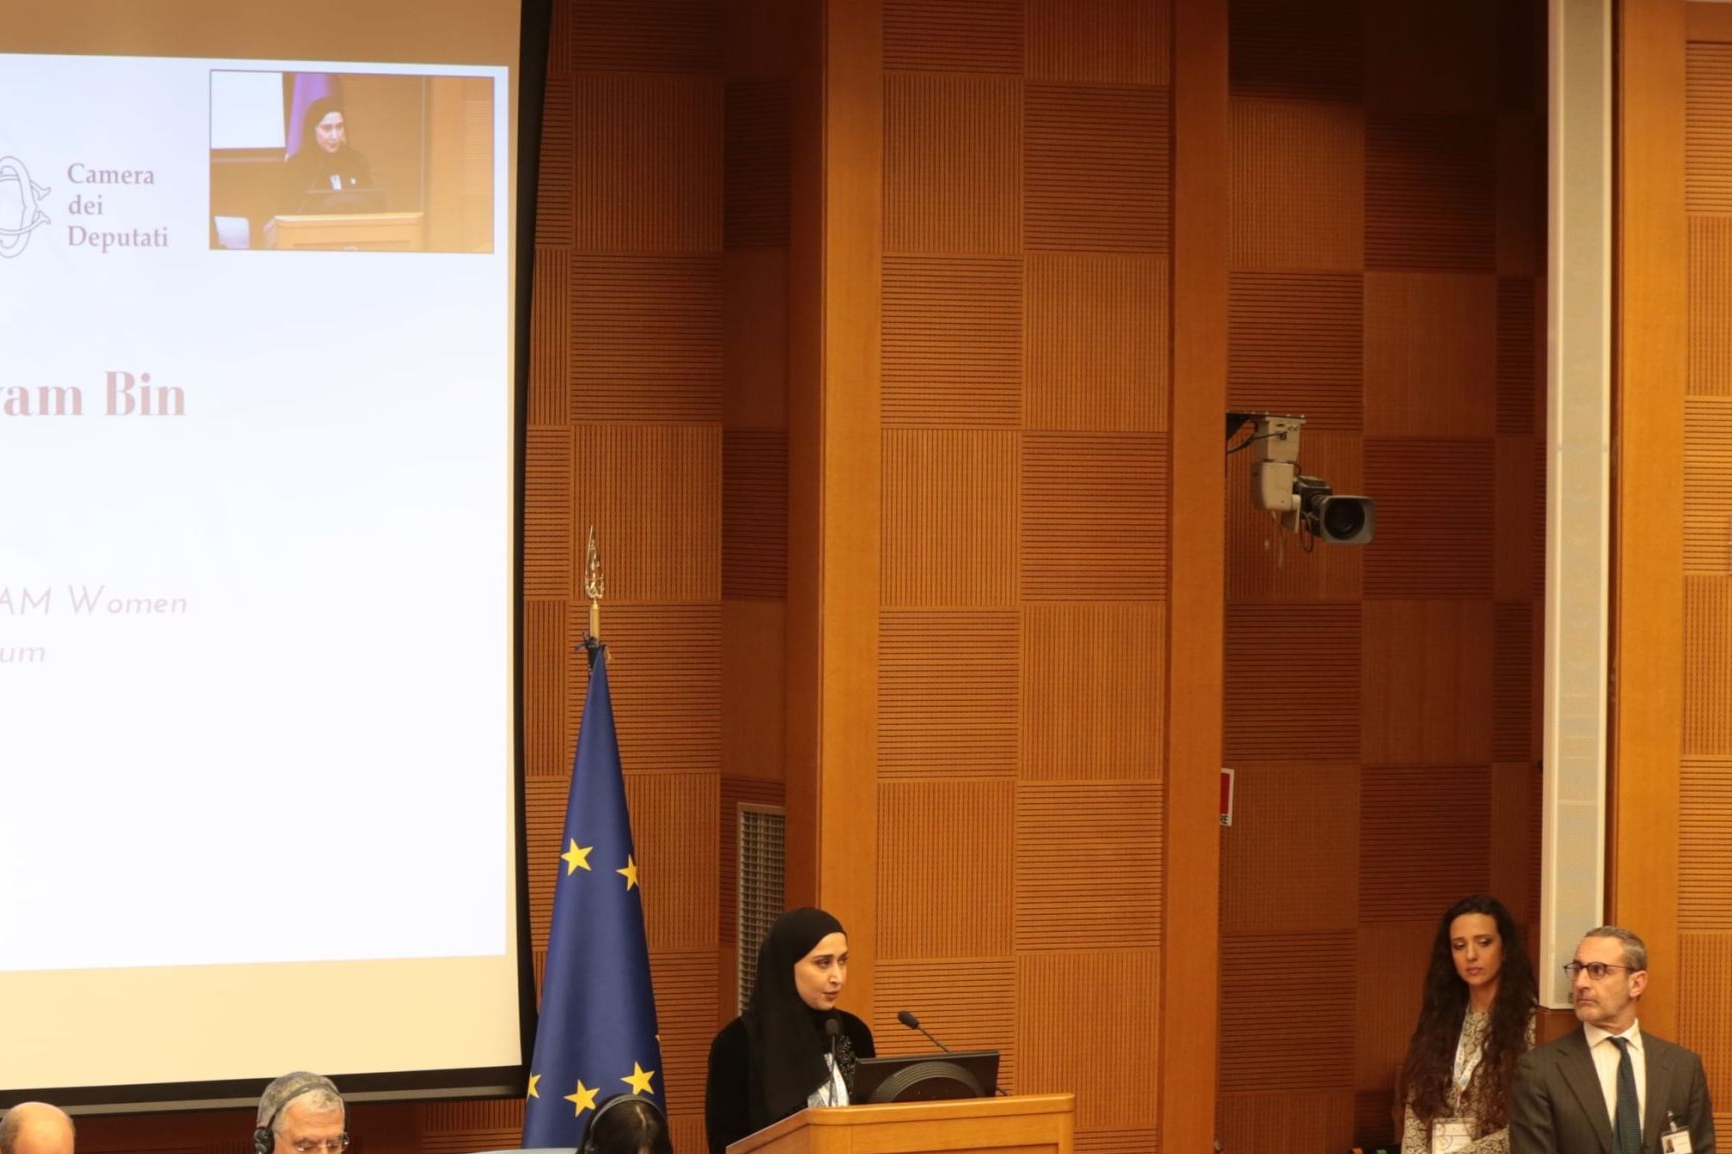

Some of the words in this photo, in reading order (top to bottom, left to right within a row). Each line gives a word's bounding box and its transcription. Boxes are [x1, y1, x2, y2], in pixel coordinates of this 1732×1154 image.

[67, 163, 155, 185] Camera
[68, 194, 104, 215] dei
[66, 225, 169, 254] Deputati
[103, 370, 188, 416] Bin
[67, 584, 188, 615] Women
